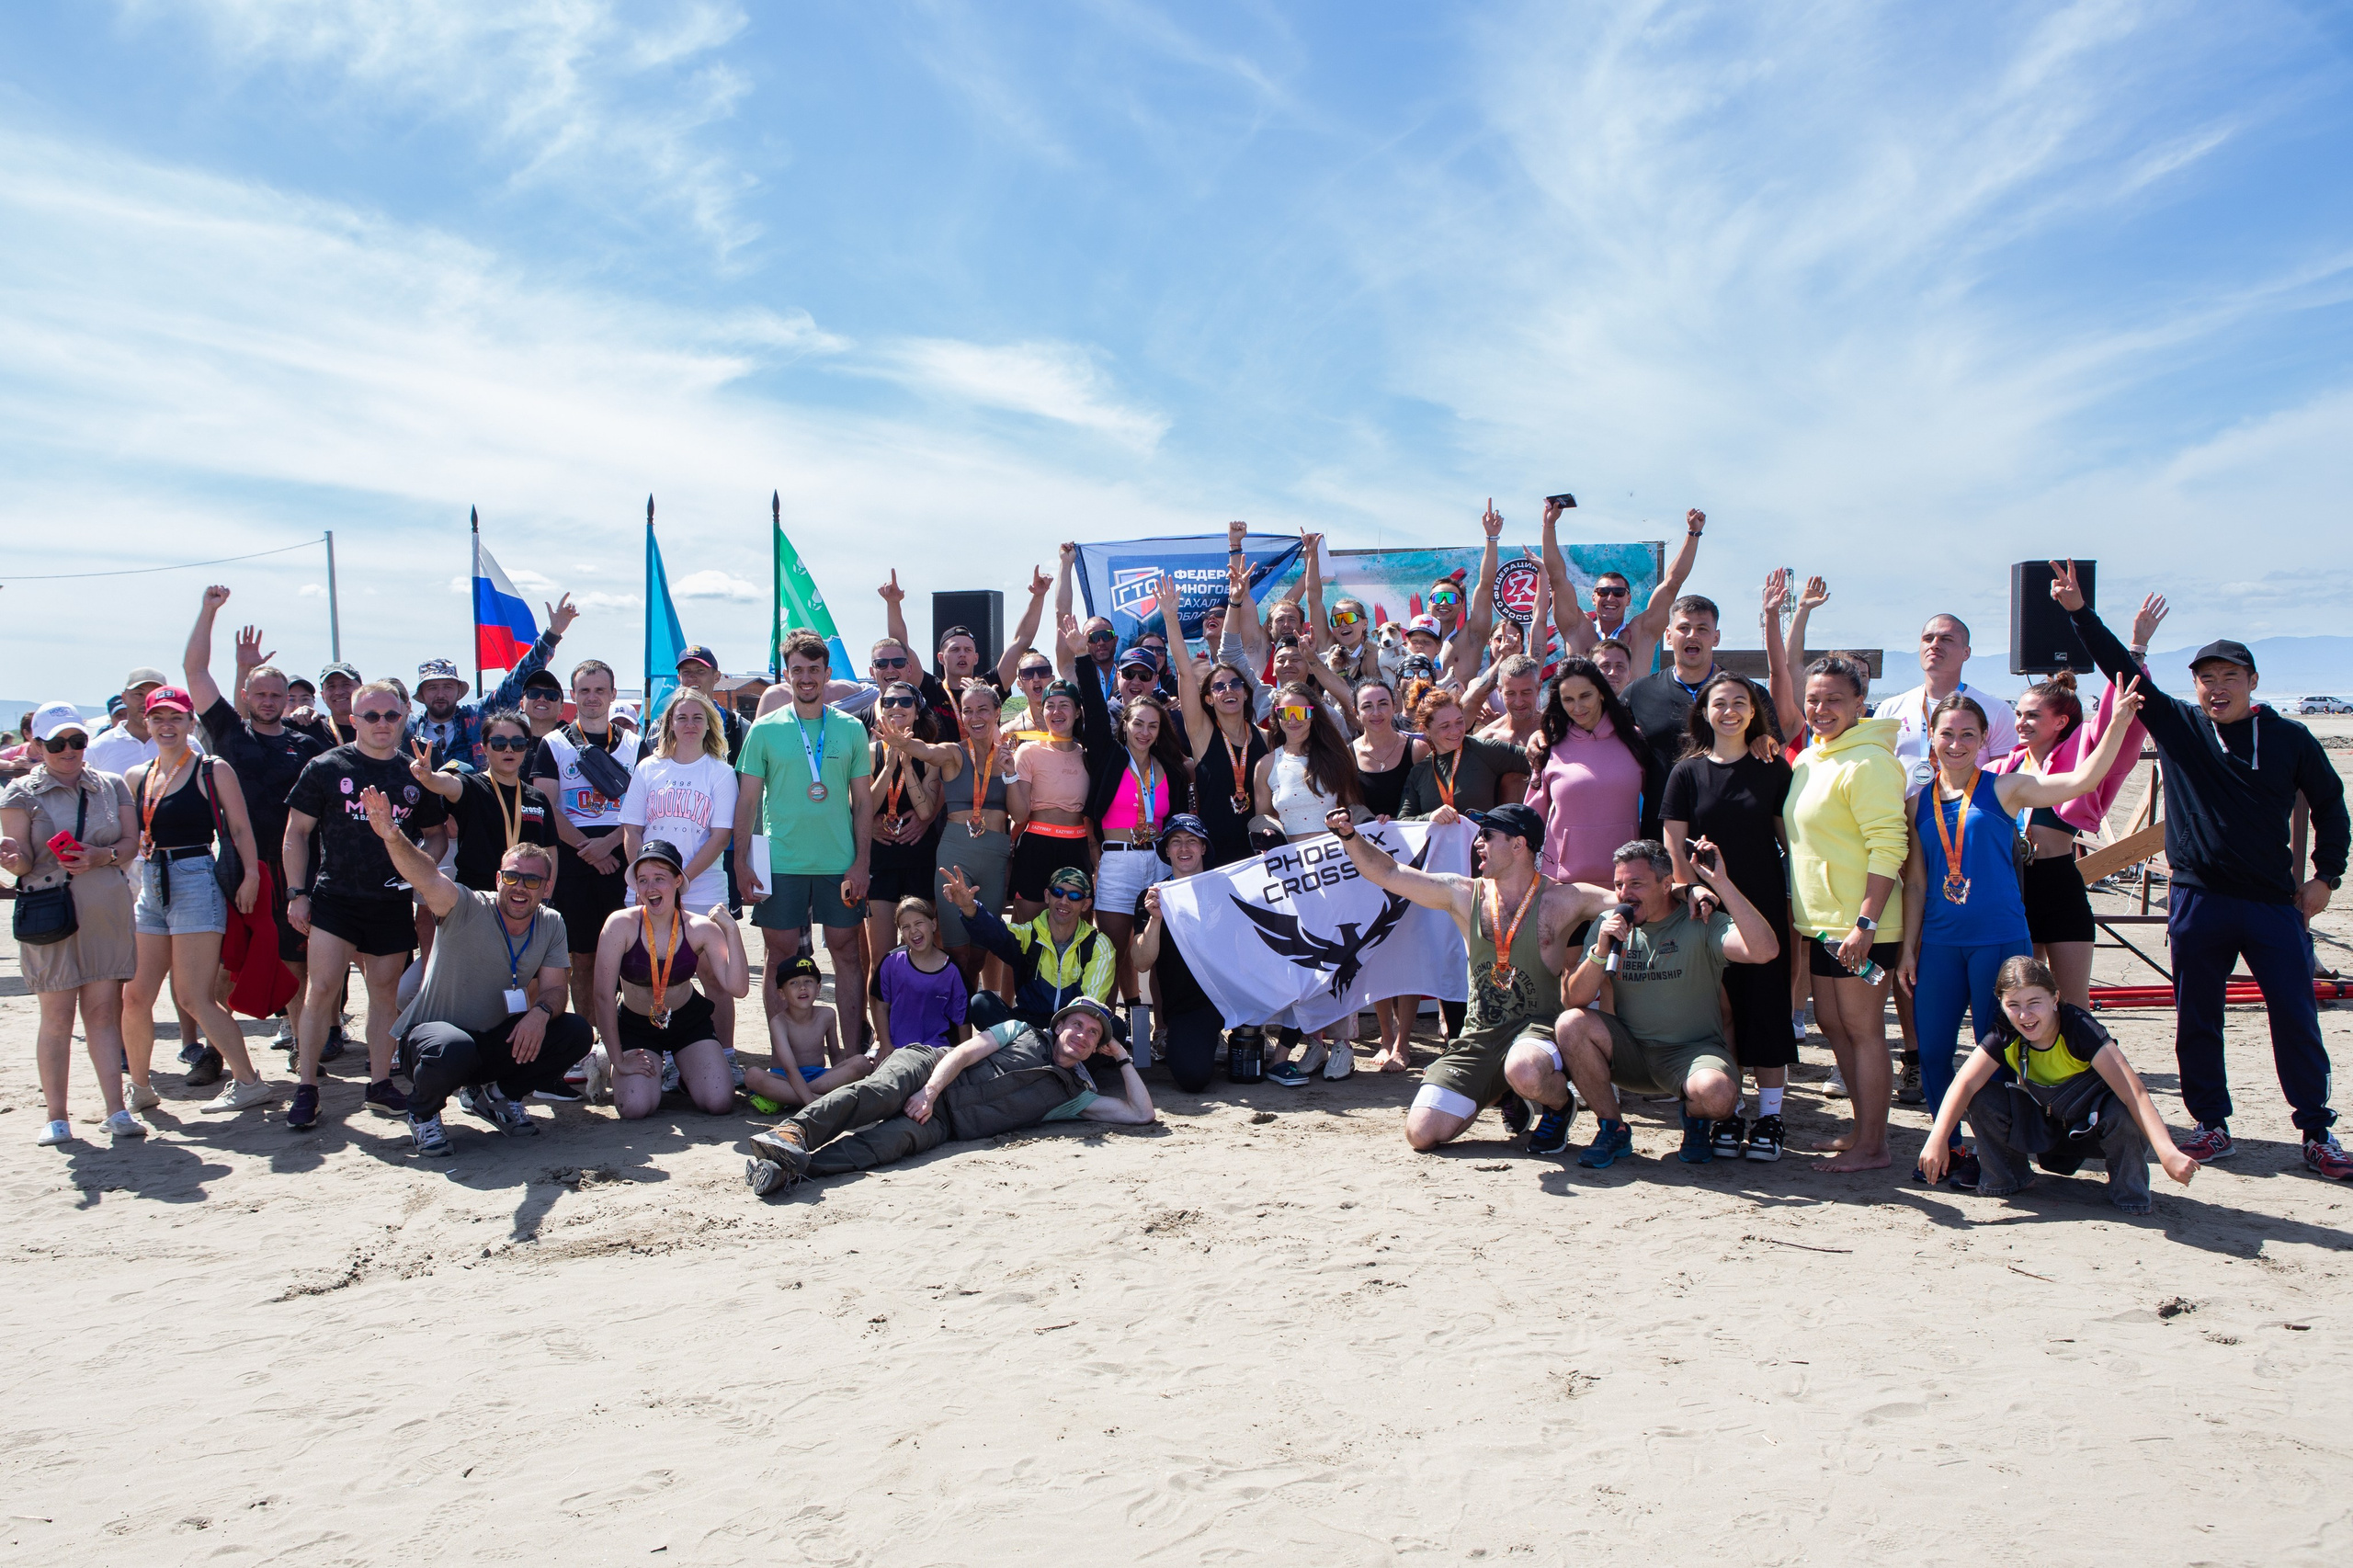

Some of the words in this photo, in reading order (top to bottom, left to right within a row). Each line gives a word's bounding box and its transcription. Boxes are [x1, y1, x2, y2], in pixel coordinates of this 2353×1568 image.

[1174, 569, 1230, 582] ФЕДЕР
[1119, 578, 1158, 604] ГТО
[1178, 597, 1220, 608] САХАЛ
[1264, 831, 1387, 878] PHOEX
[1263, 848, 1400, 904] CROSST
[1616, 969, 1683, 983] CHAMPIONSHIP
[1528, 1000, 1538, 1009] 14
